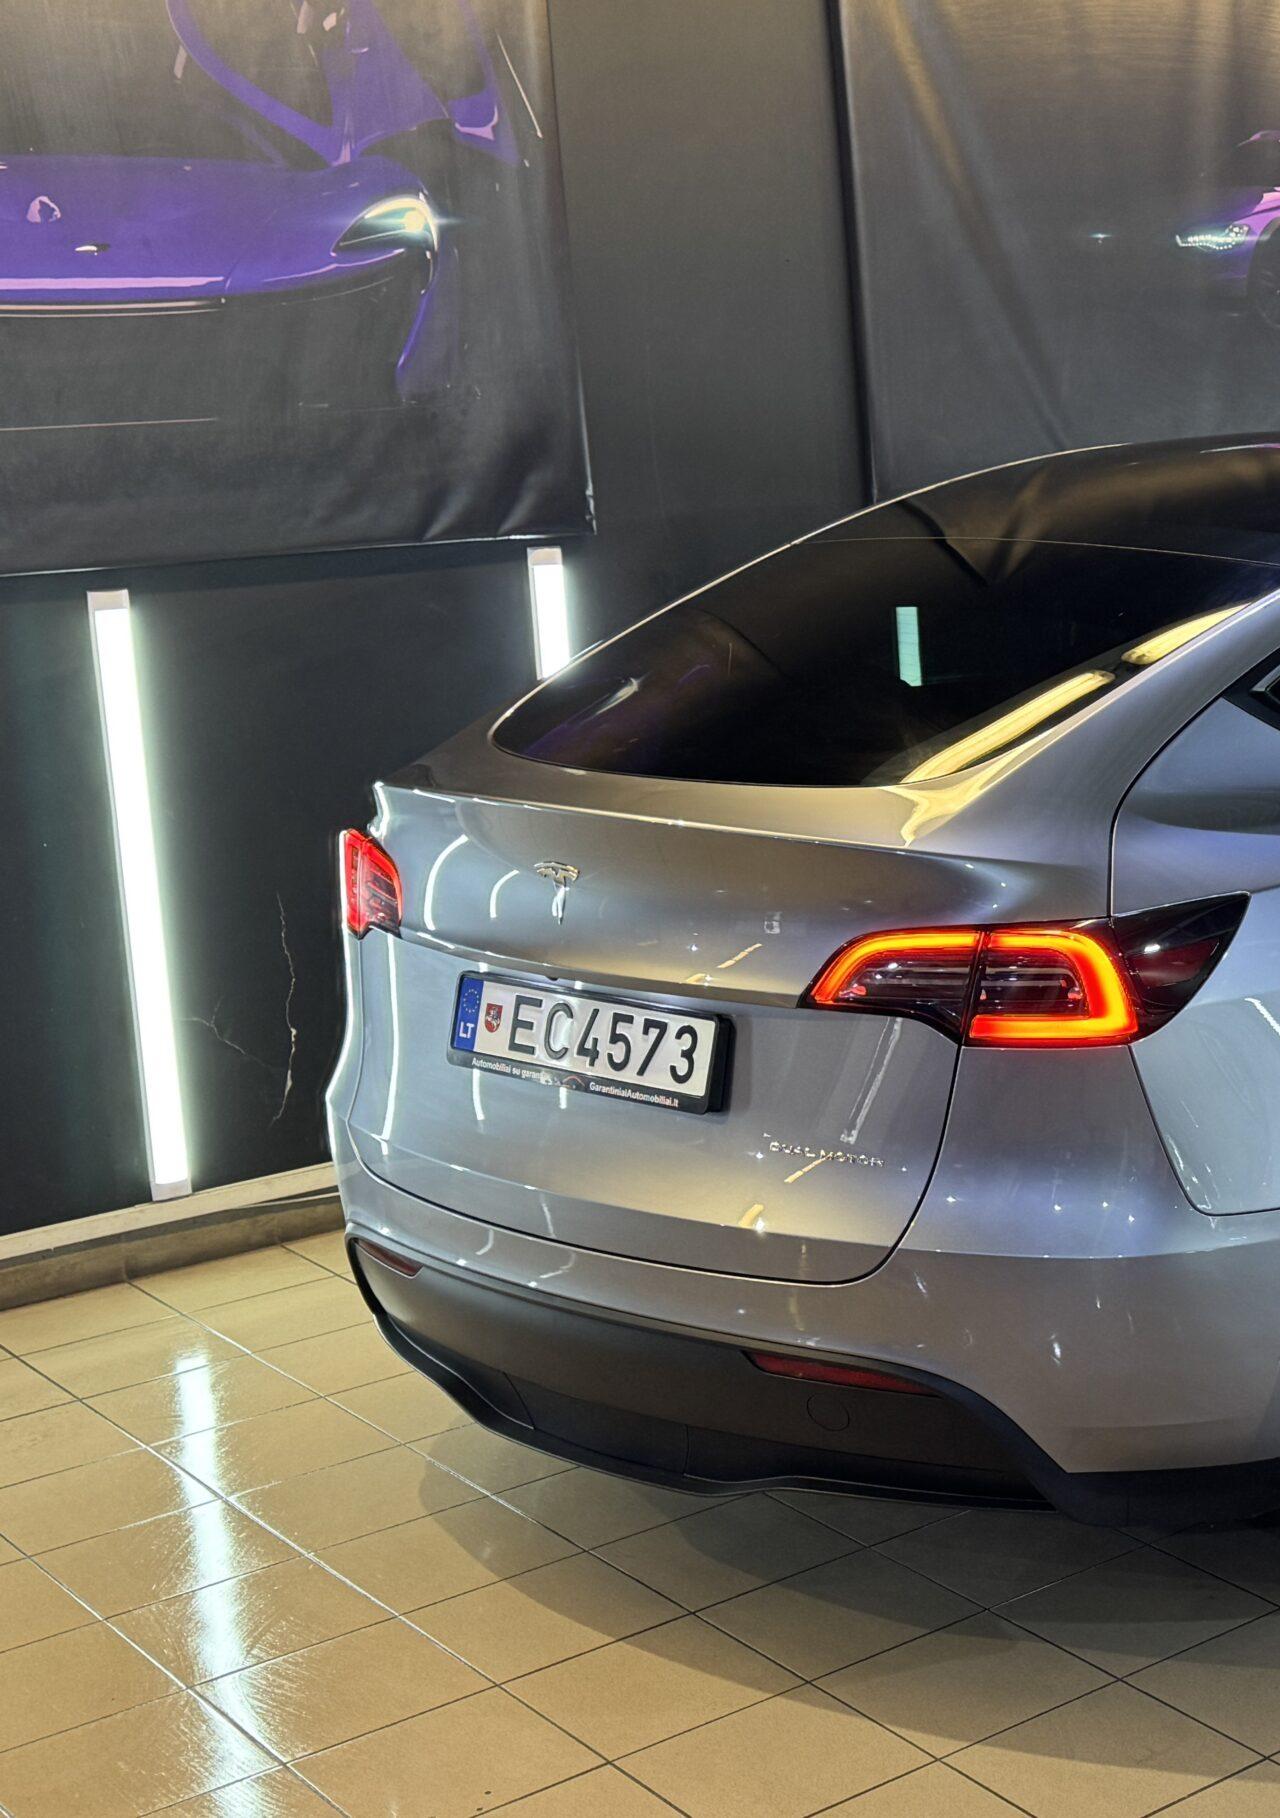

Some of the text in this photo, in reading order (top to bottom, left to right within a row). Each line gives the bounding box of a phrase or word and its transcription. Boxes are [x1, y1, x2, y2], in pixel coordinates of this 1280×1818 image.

[458, 1021, 475, 1040] LT
[507, 994, 699, 1084] EC4573
[471, 1057, 511, 1073] Automobiliai
[511, 1066, 521, 1075] su
[589, 1081, 679, 1108] GarantiniaiAutomobiliai.lt
